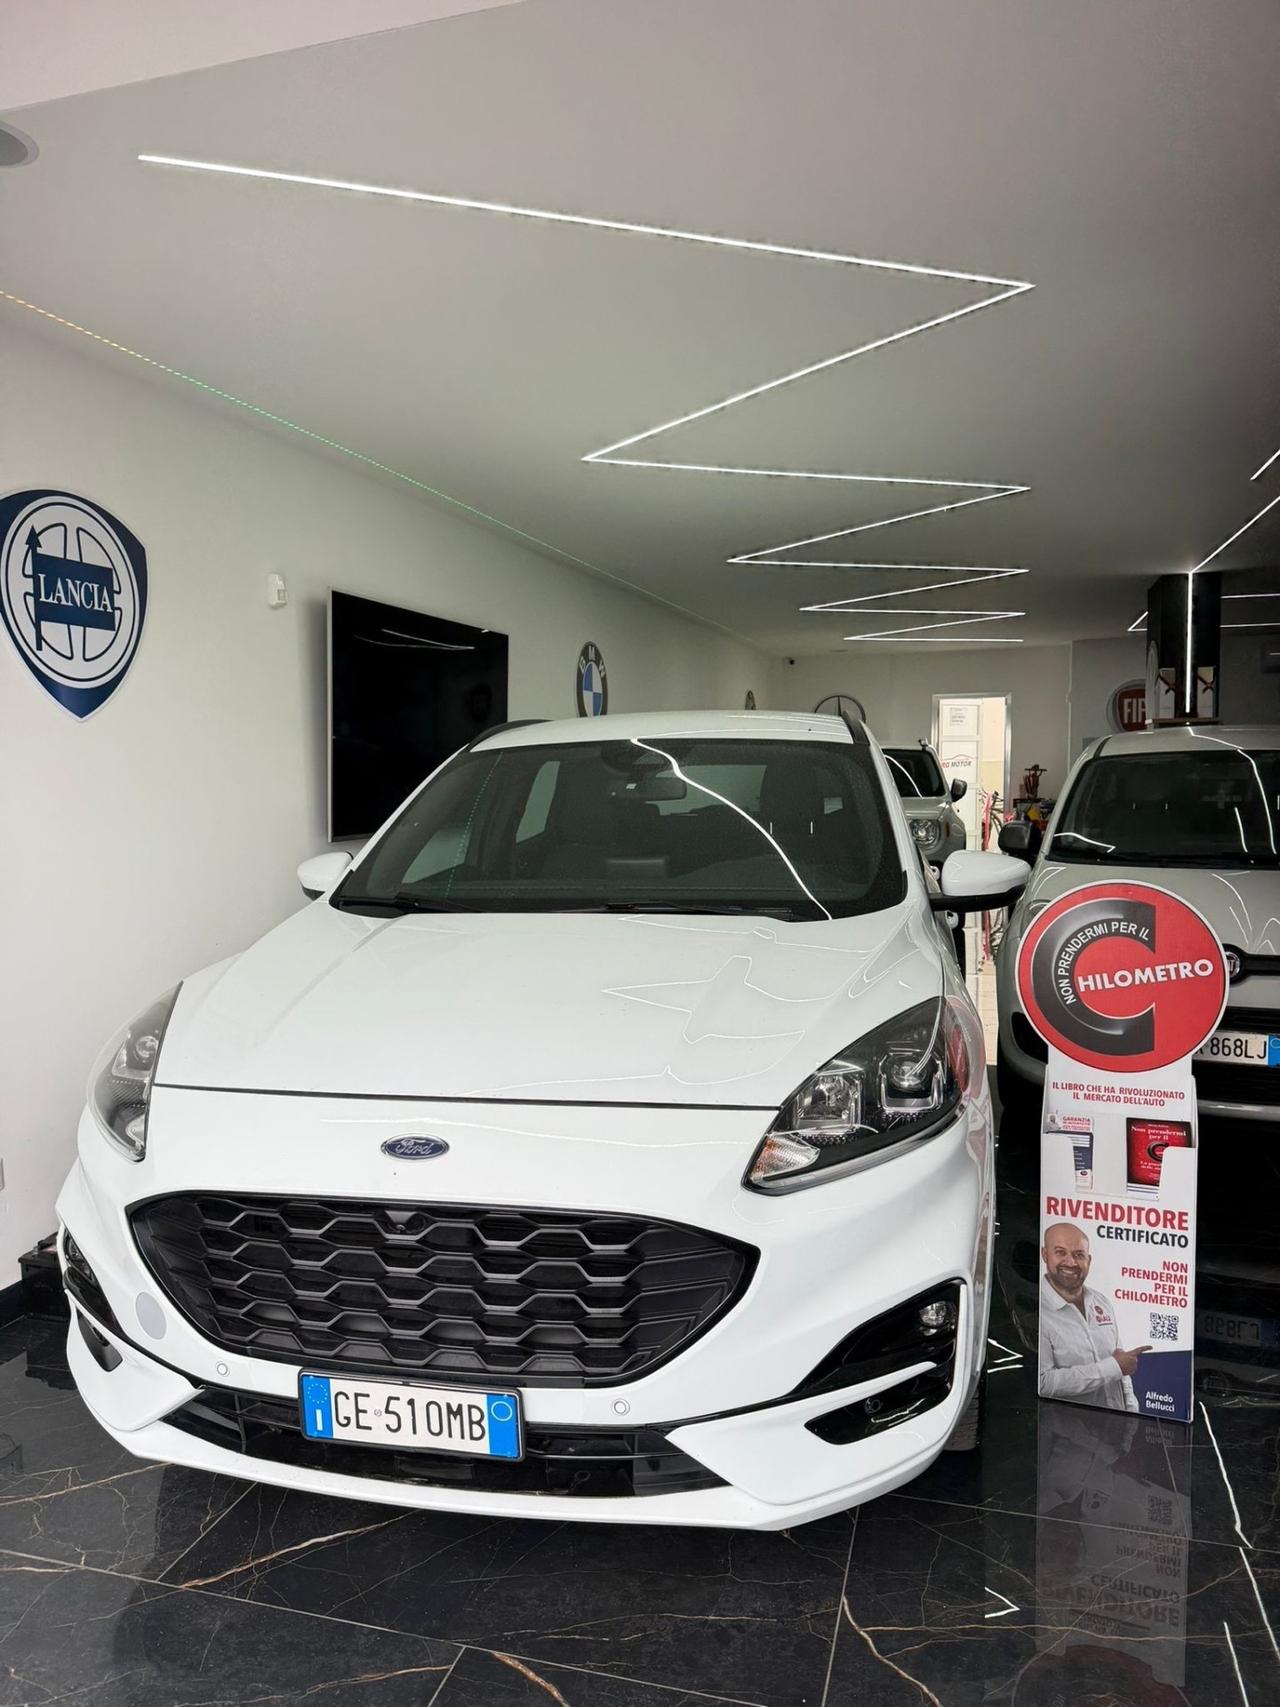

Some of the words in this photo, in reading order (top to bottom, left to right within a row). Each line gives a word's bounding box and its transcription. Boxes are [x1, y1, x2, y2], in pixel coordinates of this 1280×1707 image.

[38, 573, 113, 613] LANCIA
[1111, 921, 1138, 935] PER
[1139, 927, 1150, 941] IL
[1057, 923, 1108, 976] PRENDERMI
[1058, 979, 1077, 1005] NON
[1052, 1081, 1060, 1090] IL
[1061, 1082, 1085, 1092] LIBRO
[1086, 1084, 1102, 1093] CHE
[1104, 1086, 1116, 1094] HA
[1119, 1087, 1185, 1100] RIVOLUZIONATO
[1072, 1092, 1080, 1100] IL
[1083, 1093, 1122, 1103] MERCATO
[1123, 1096, 1165, 1107] DELL'AUTO
[395, 1138, 435, 1154] Ford
[1046, 1196, 1189, 1231] RIVENDITORE
[1096, 1225, 1189, 1248] CERTIFICATO
[1162, 1260, 1188, 1273] NON
[1121, 1267, 1188, 1285] PRENDERMI
[1114, 1288, 1188, 1308] CHILOMETRO
[1154, 1283, 1177, 1295] PER
[1179, 1285, 1188, 1297] IL
[1145, 1391, 1173, 1403] Alfredo
[1145, 1400, 1175, 1412] Bellucci
